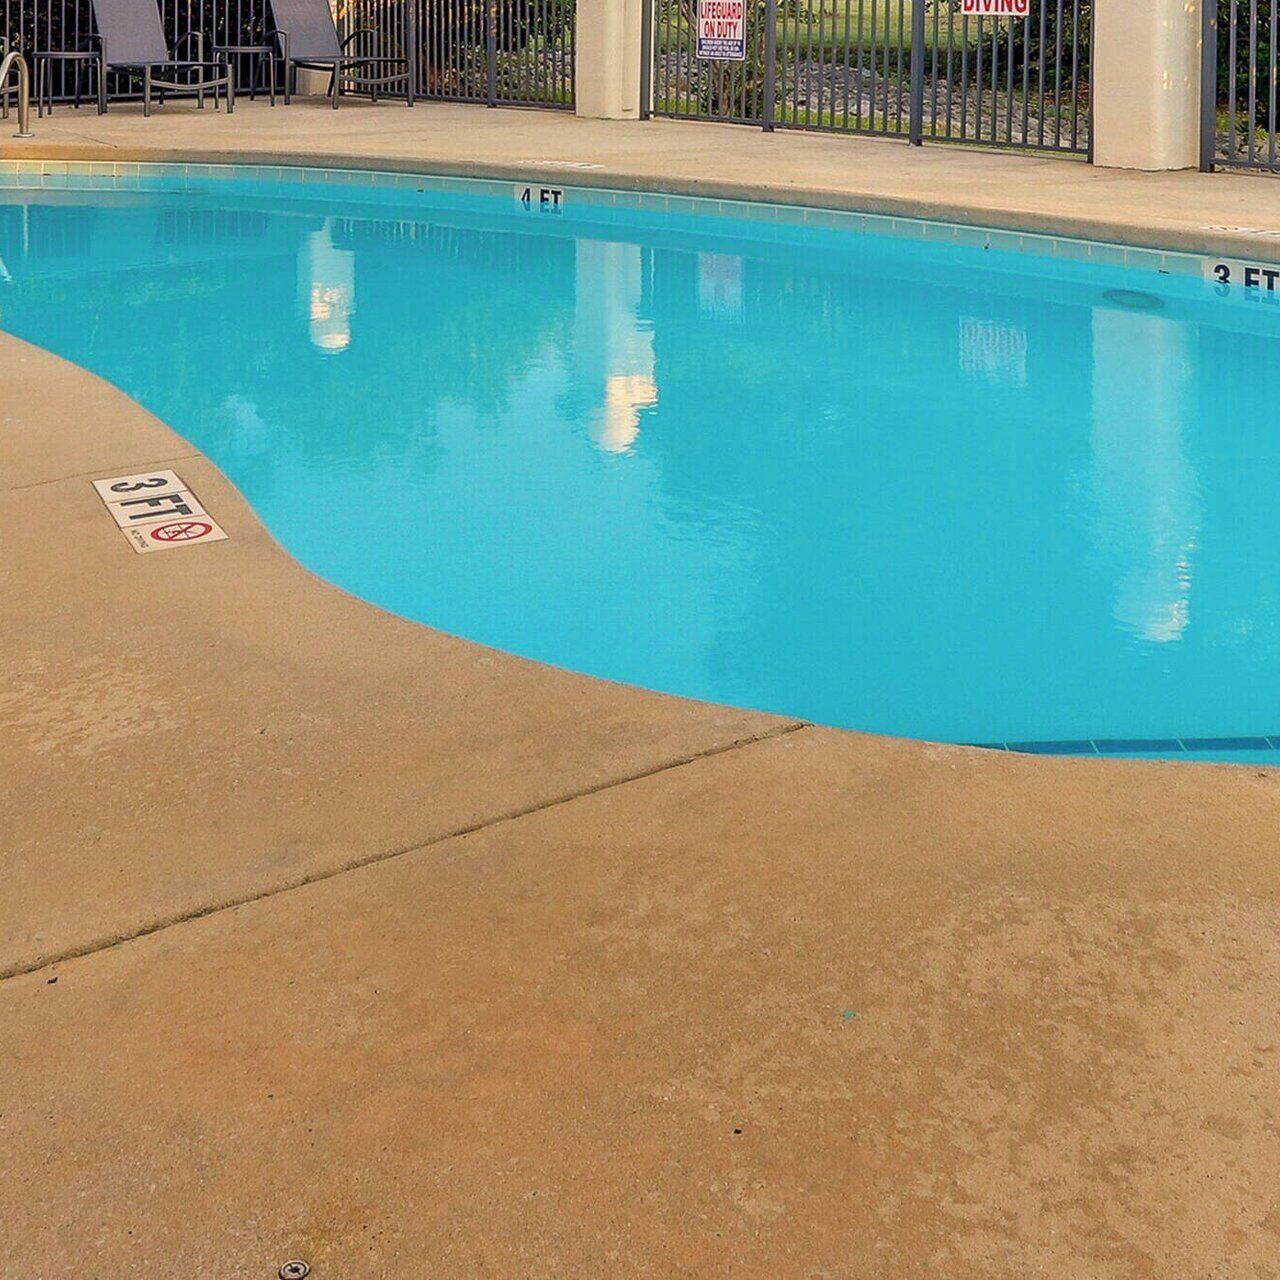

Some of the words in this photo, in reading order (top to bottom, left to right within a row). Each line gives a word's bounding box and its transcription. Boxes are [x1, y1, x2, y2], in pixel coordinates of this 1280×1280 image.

[701, 2, 742, 19] LIFEGUARD
[704, 20, 715, 38] ON
[717, 20, 738, 38] DUTY
[540, 189, 562, 207] FT
[1214, 264, 1231, 287] 3
[1245, 267, 1280, 294] FT
[110, 477, 168, 493] 3
[120, 493, 194, 520] FT
